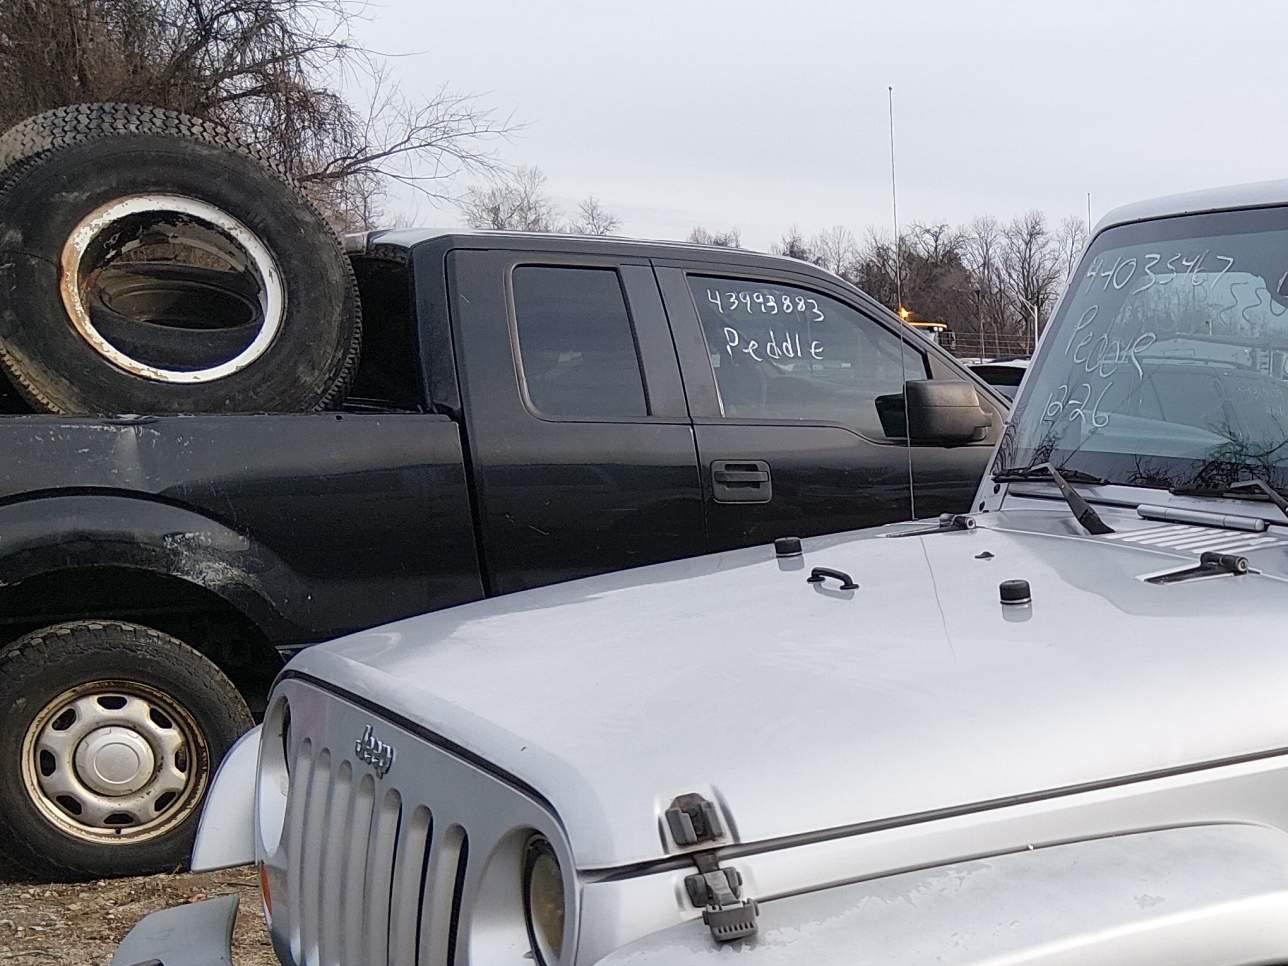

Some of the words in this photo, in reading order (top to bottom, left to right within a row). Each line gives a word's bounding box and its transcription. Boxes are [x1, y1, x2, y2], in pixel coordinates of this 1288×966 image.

[707, 288, 825, 322] 43993883
[724, 327, 824, 362] Peddle
[355, 724, 394, 779] Jeep
